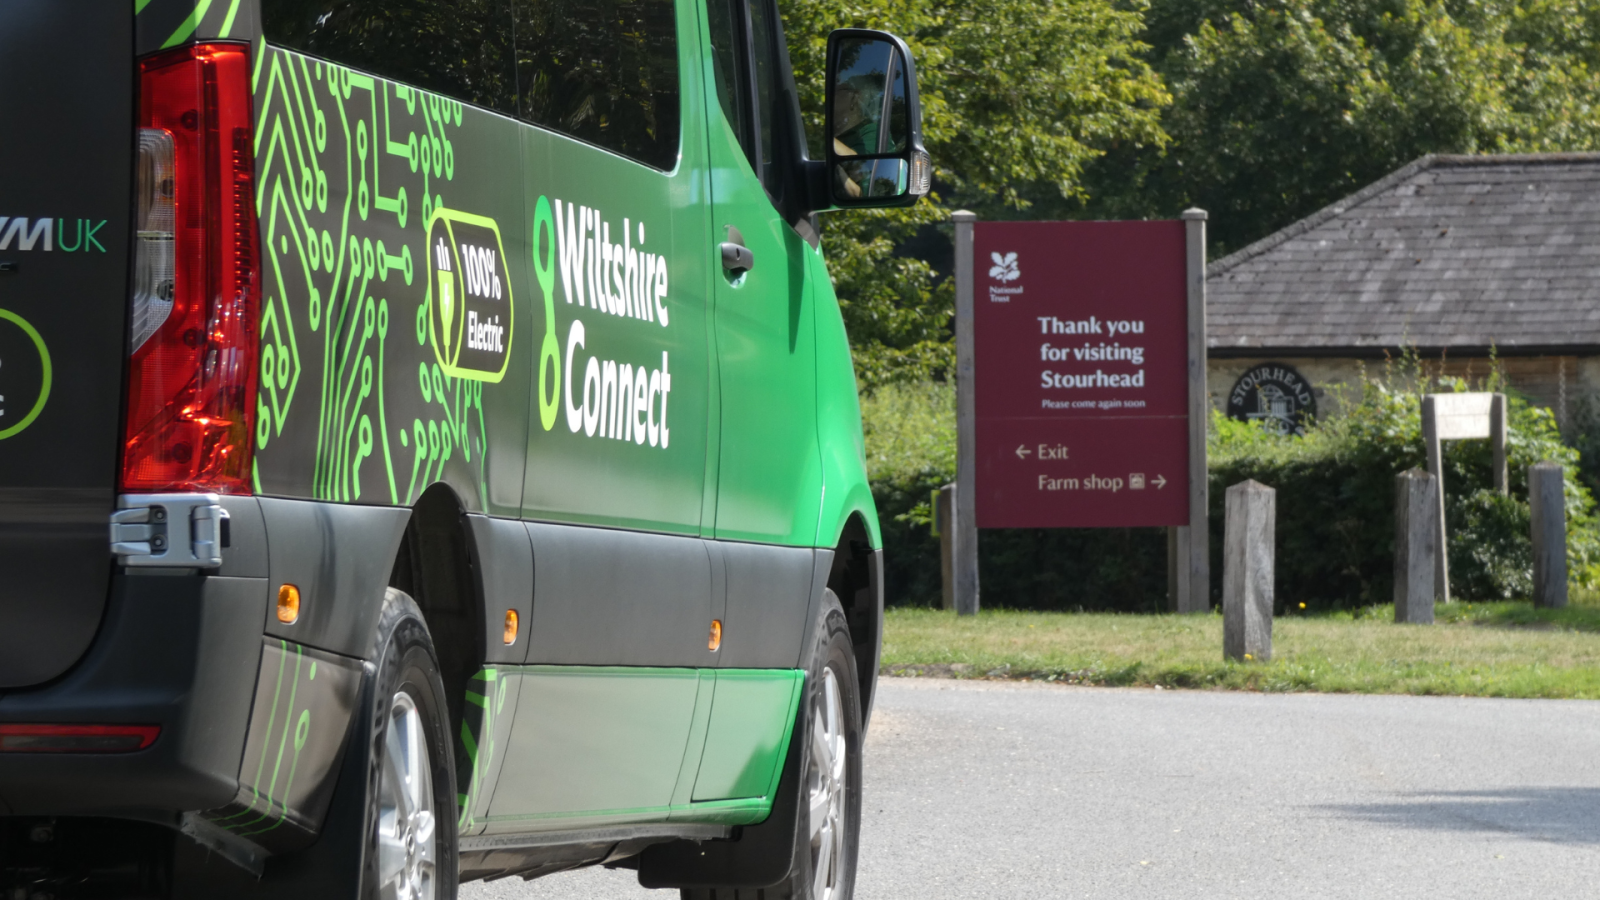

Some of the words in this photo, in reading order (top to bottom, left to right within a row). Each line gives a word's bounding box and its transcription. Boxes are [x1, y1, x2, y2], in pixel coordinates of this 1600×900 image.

[462, 244, 502, 300] 100%
[555, 198, 669, 328] Wiltshire
[988, 285, 1024, 295] National
[989, 294, 1011, 303] Trust
[468, 310, 504, 353] Electric
[1037, 315, 1103, 335] Thank
[1106, 319, 1145, 338] you
[1040, 343, 1070, 361] for
[1073, 342, 1145, 365] visiting
[565, 319, 671, 449] Connect
[1040, 369, 1145, 389] Stourhead
[1231, 367, 1311, 407] STOURHEAD
[1041, 399, 1070, 409] Please
[1071, 400, 1096, 409] come
[1097, 399, 1122, 410] again
[1123, 400, 1146, 409] soon
[1038, 443, 1069, 460] Exit
[1038, 474, 1079, 490] Farm
[1083, 474, 1124, 493] shop
